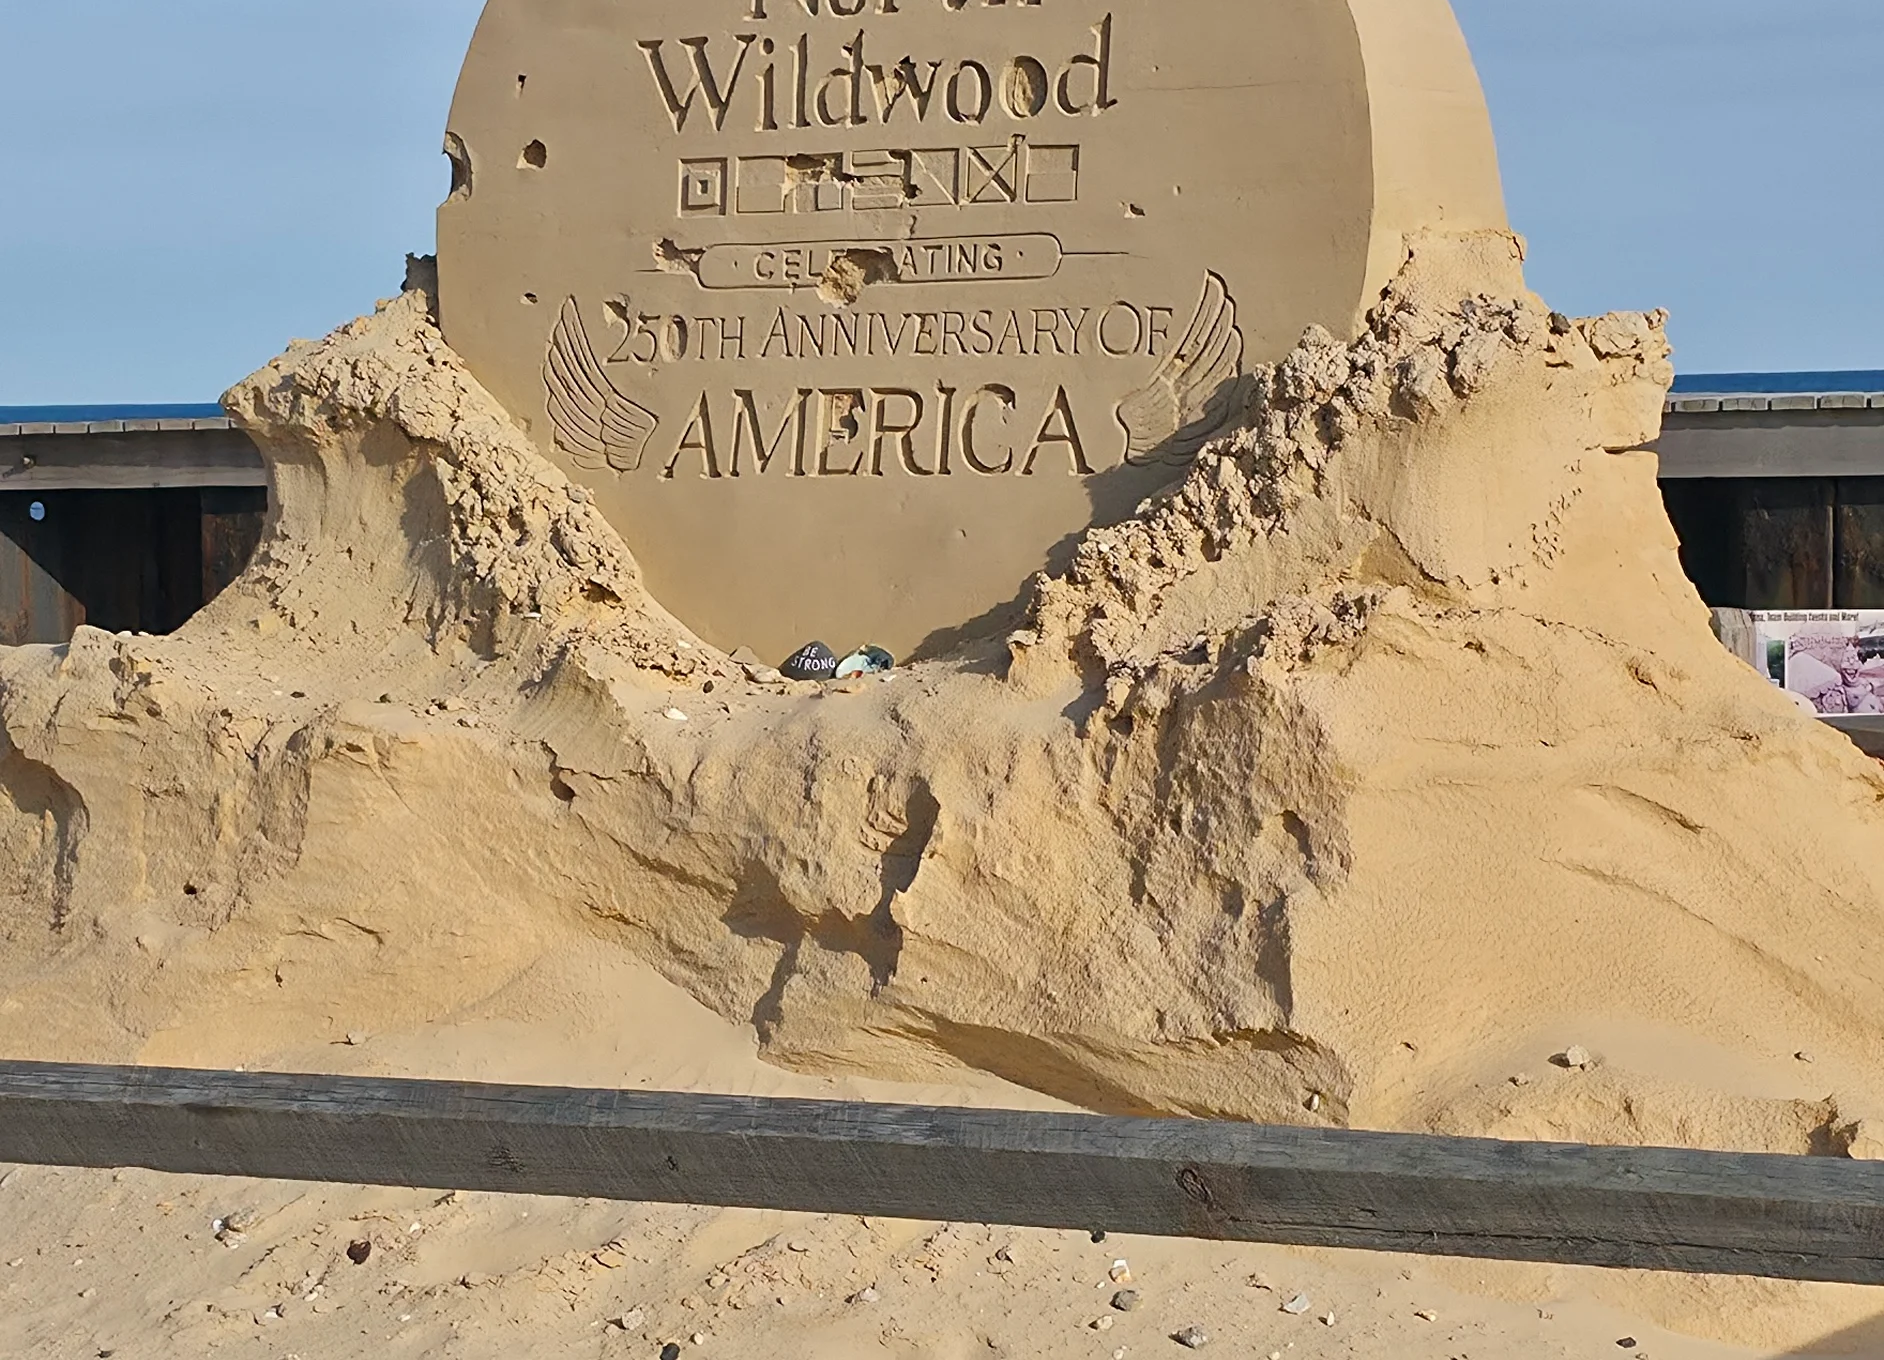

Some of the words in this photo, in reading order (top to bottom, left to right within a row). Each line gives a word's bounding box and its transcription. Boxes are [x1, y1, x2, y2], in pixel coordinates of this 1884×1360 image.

[636, 12, 1119, 135] Wildwood
[602, 310, 746, 366] 250TH
[761, 306, 1090, 361] ANNIVERSARY
[1097, 300, 1175, 357] OF
[657, 382, 1097, 479] AMERICA
[791, 655, 836, 671] STRONG
